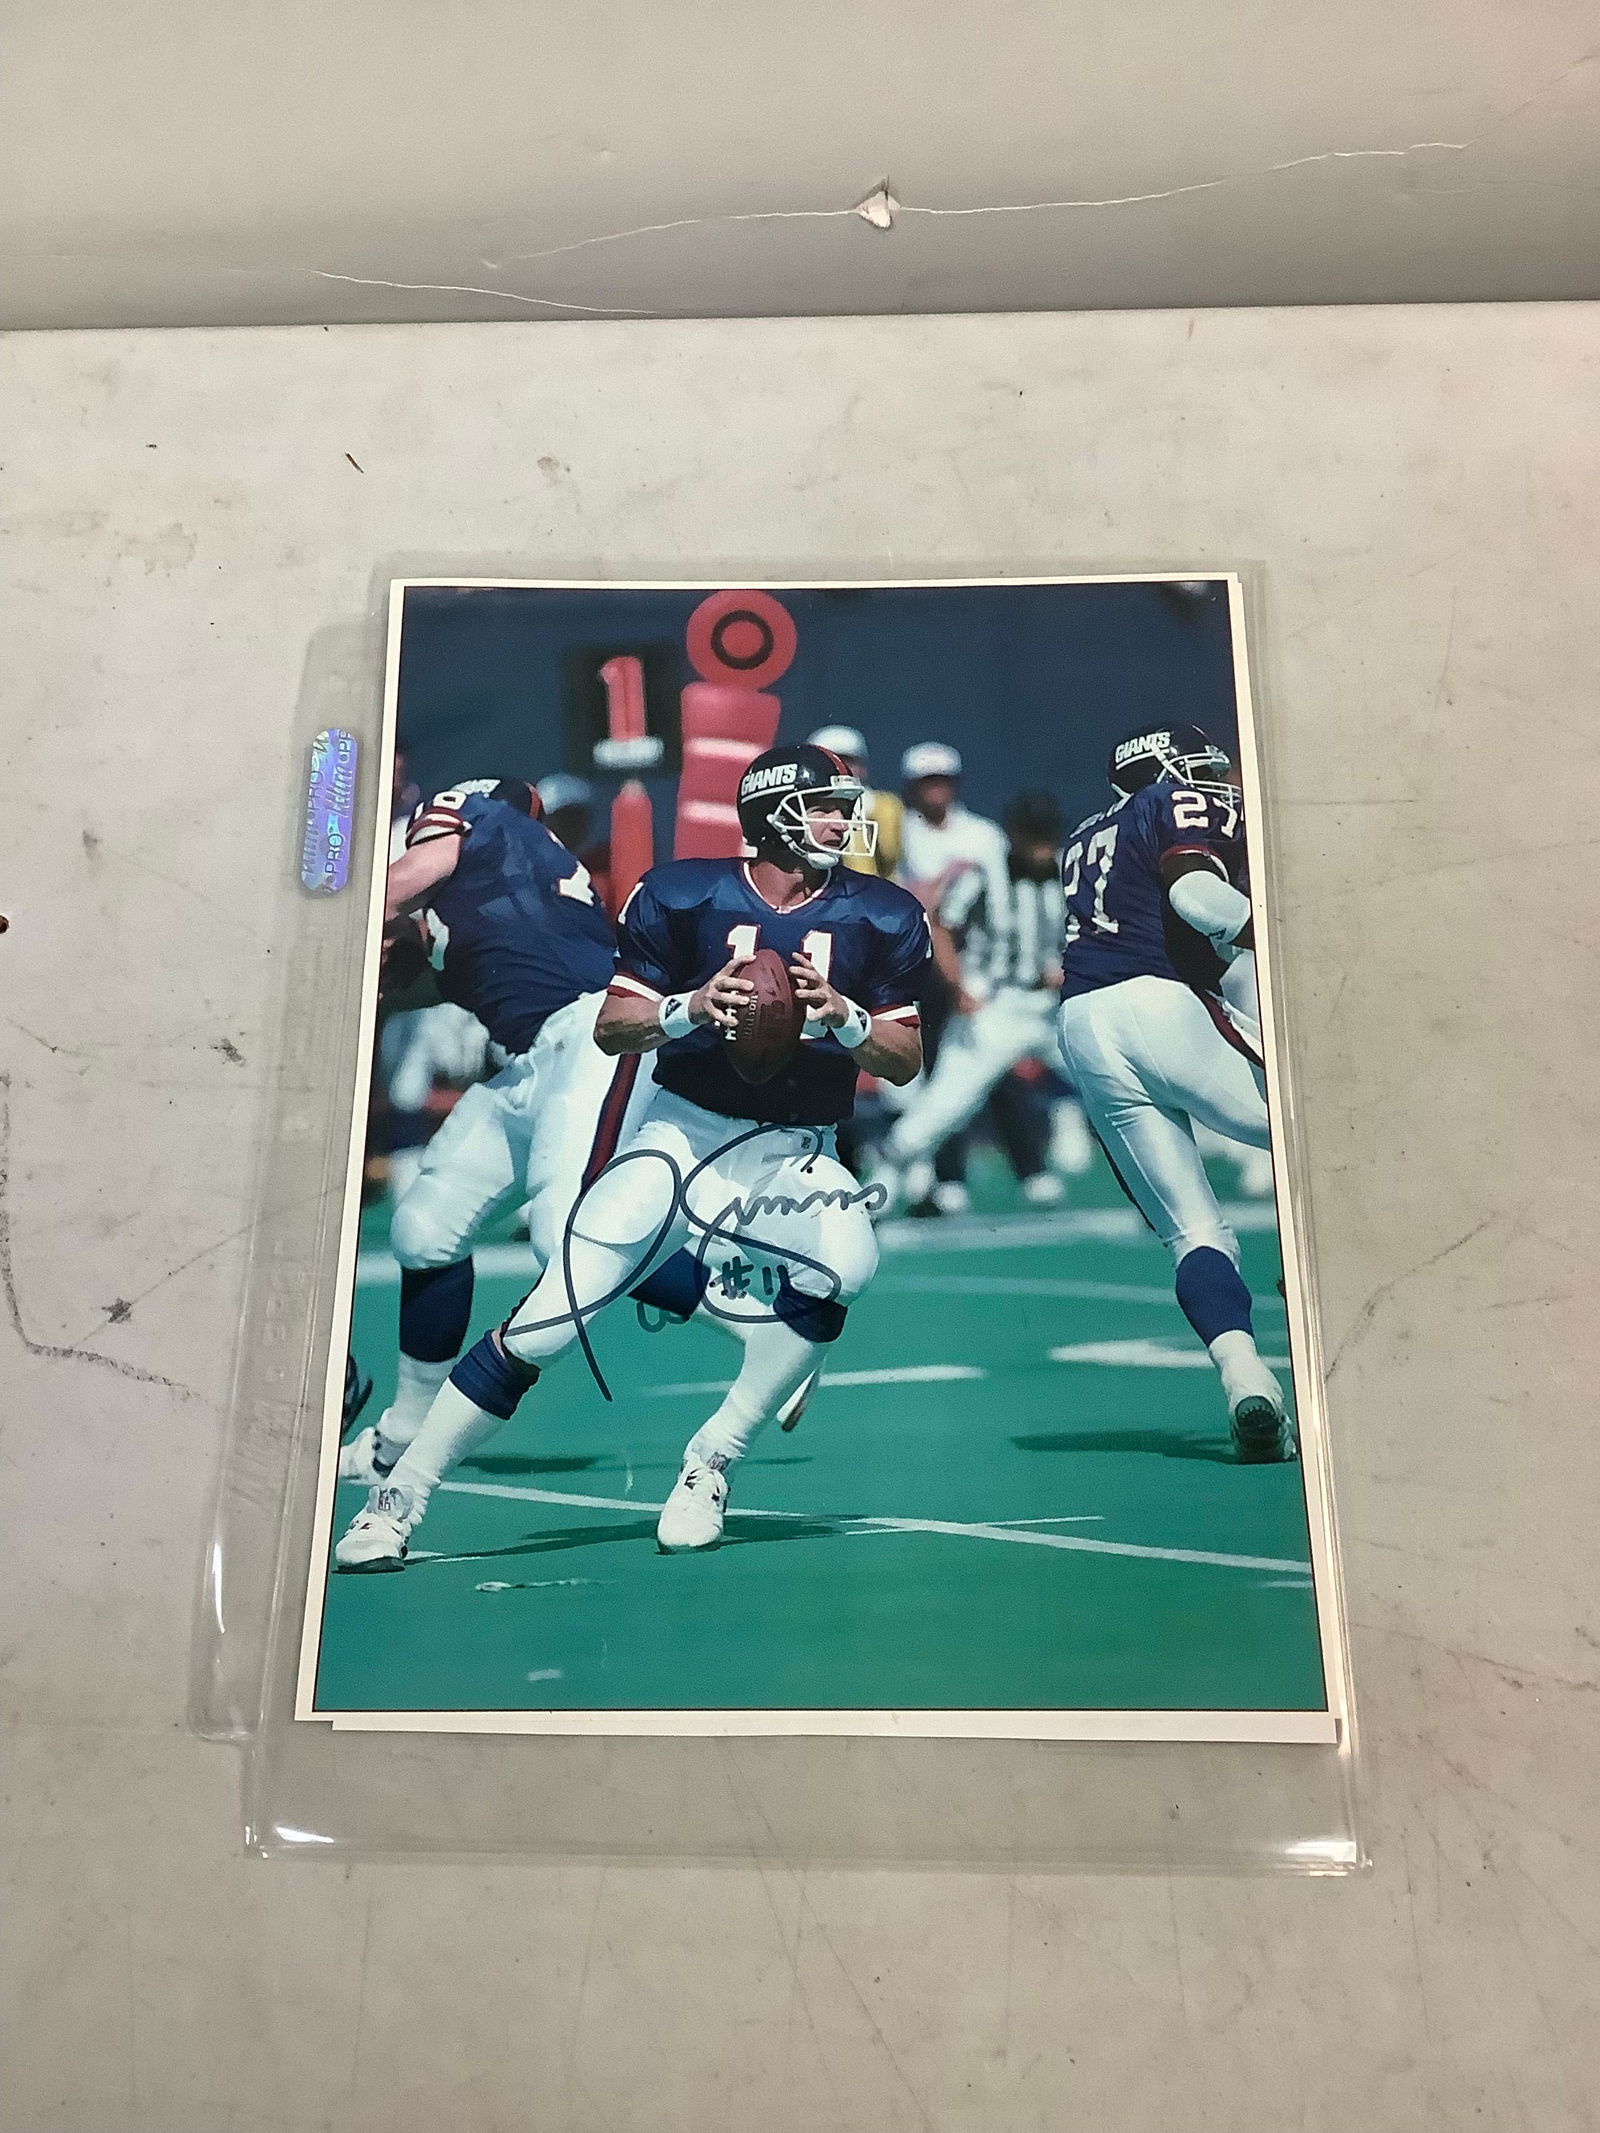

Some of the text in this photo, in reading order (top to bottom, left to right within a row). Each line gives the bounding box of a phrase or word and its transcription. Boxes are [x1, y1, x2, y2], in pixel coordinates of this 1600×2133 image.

[1115, 732, 1171, 763] GIANTS
[741, 763, 798, 796] GIANTS
[1171, 790, 1238, 839] 27
[325, 833, 344, 874] PRO
